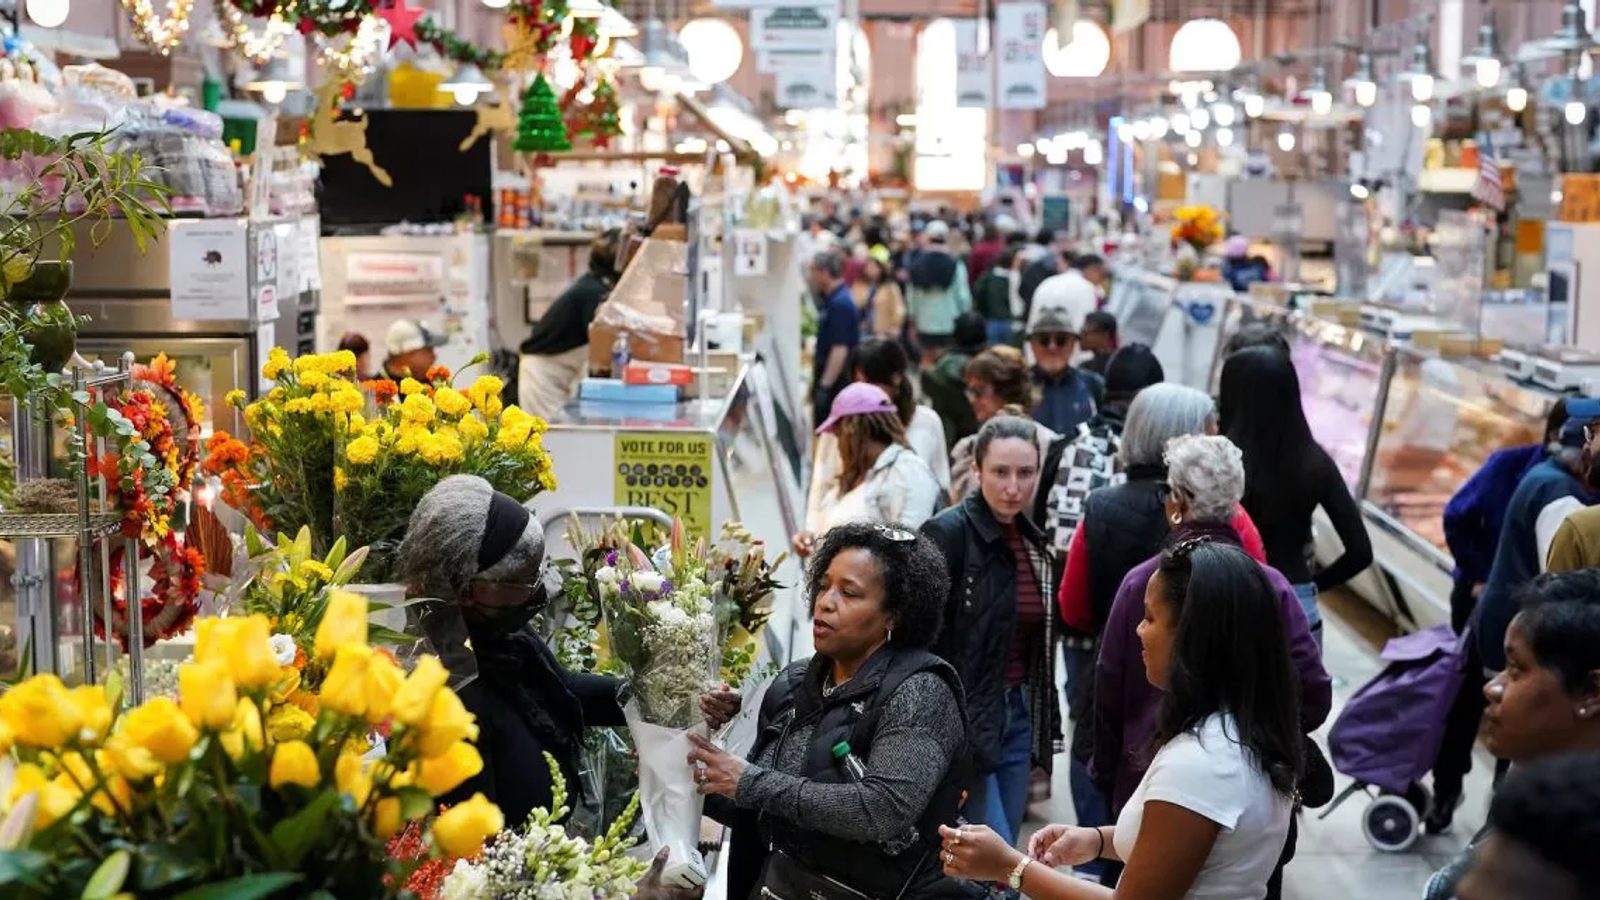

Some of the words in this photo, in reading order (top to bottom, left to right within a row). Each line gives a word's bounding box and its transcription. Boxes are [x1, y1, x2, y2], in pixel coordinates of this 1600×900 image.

[621, 441, 654, 453] VOTE
[659, 441, 685, 454] FOR
[688, 442, 706, 454] US
[627, 490, 699, 514] BEST
